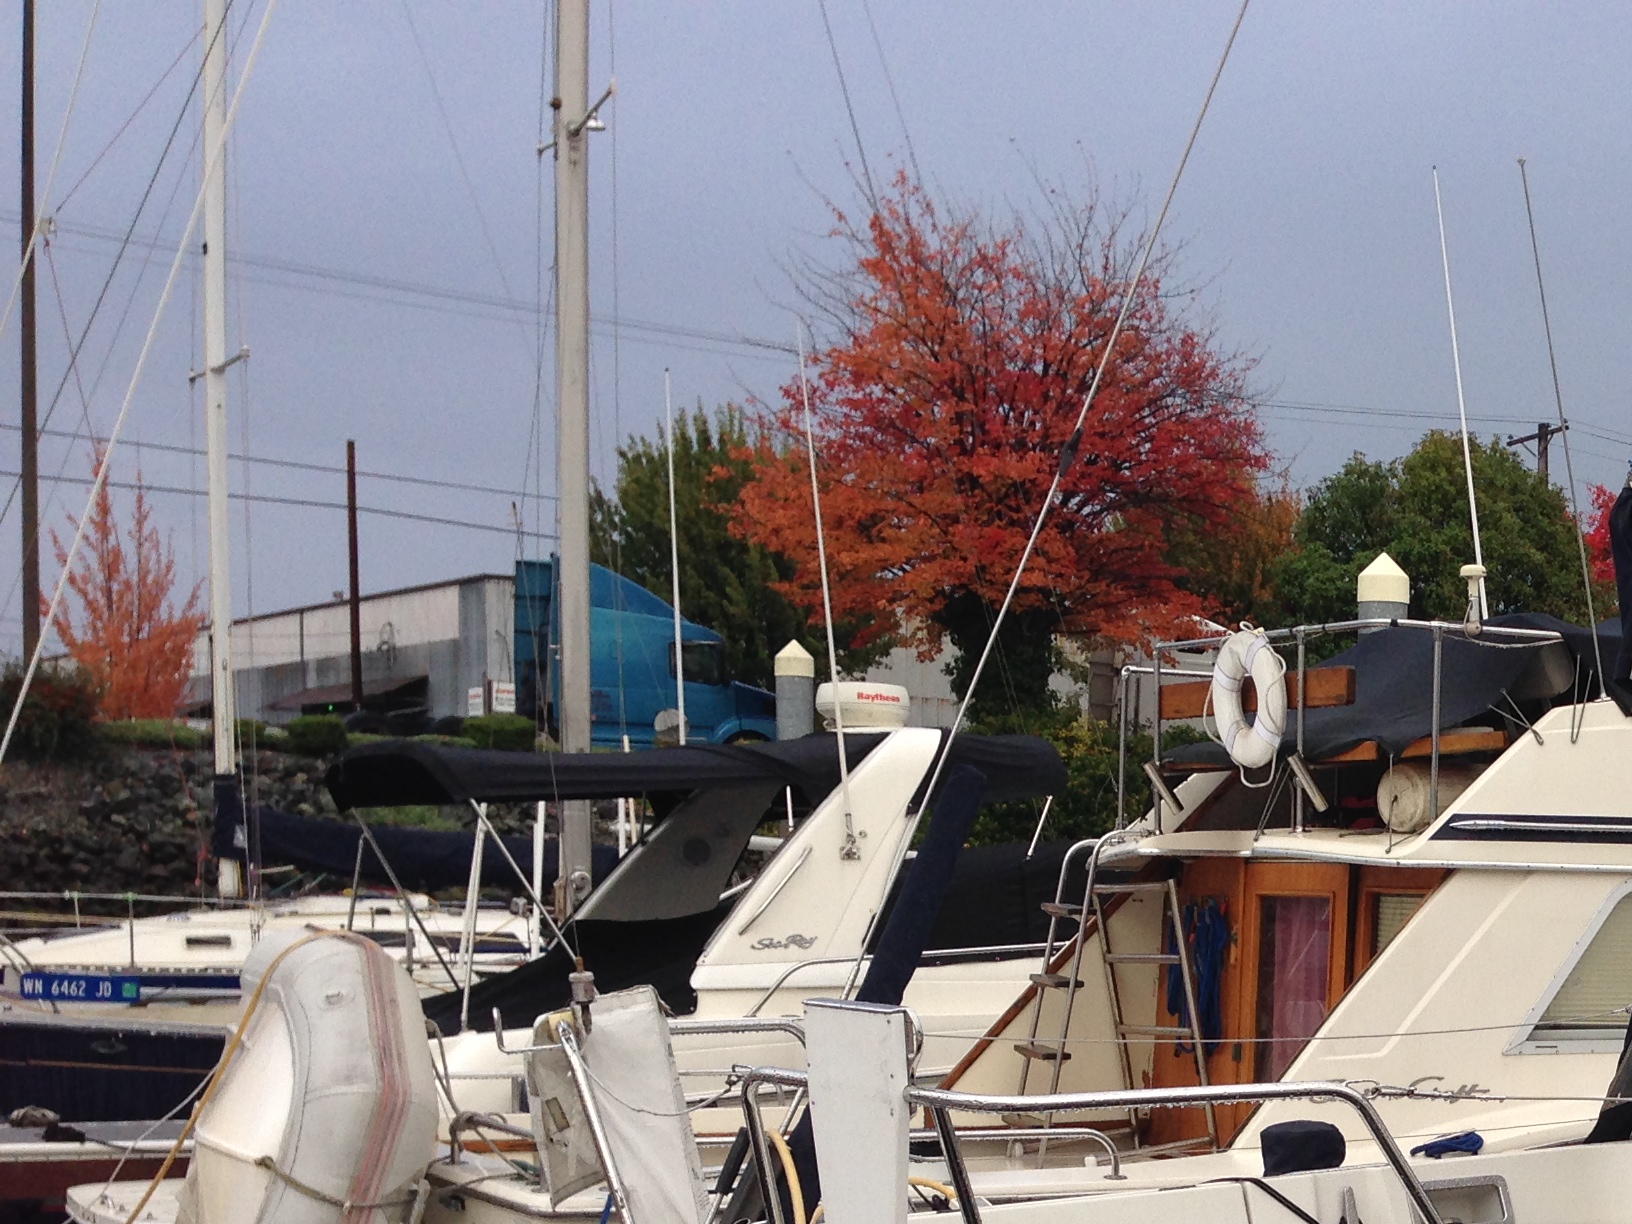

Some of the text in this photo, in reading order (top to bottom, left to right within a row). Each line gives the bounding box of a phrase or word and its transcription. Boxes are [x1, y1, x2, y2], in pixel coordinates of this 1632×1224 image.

[23, 978, 43, 995] WN
[51, 979, 87, 998] 6462
[95, 981, 112, 998] JD
